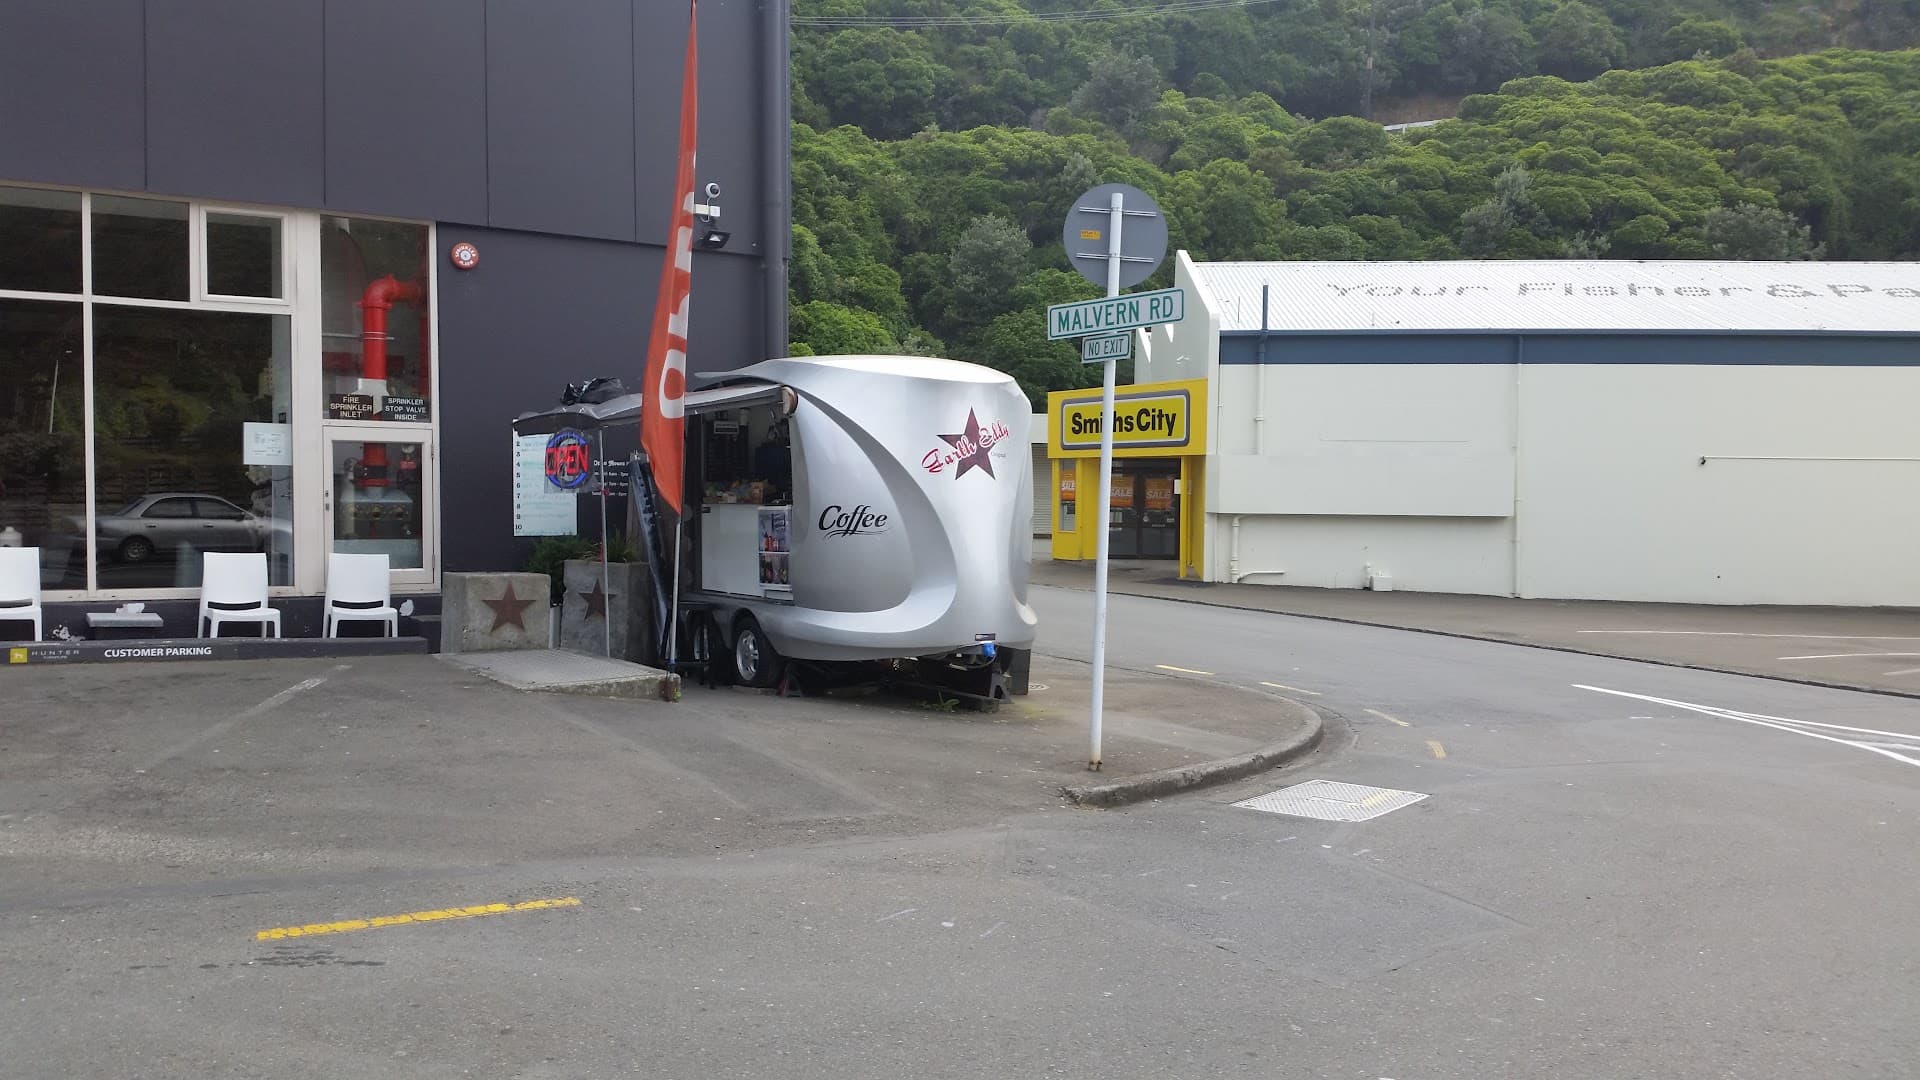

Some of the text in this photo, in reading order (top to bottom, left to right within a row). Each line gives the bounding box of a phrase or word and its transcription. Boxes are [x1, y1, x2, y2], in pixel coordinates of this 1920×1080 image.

[1327, 283, 1489, 297] Your
[1058, 295, 1174, 333] MALVERN RD
[1088, 338, 1125, 357] NO EXIT
[342, 396, 360, 404] FIRE
[387, 397, 424, 405] SPRINKLER
[330, 403, 373, 411] SPRINKLER
[340, 410, 363, 418] INLET
[394, 413, 417, 421] INSIDE
[545, 444, 589, 476] OPEN
[818, 504, 888, 538] Coffee
[104, 646, 212, 658] CUSTOMER PARKING
